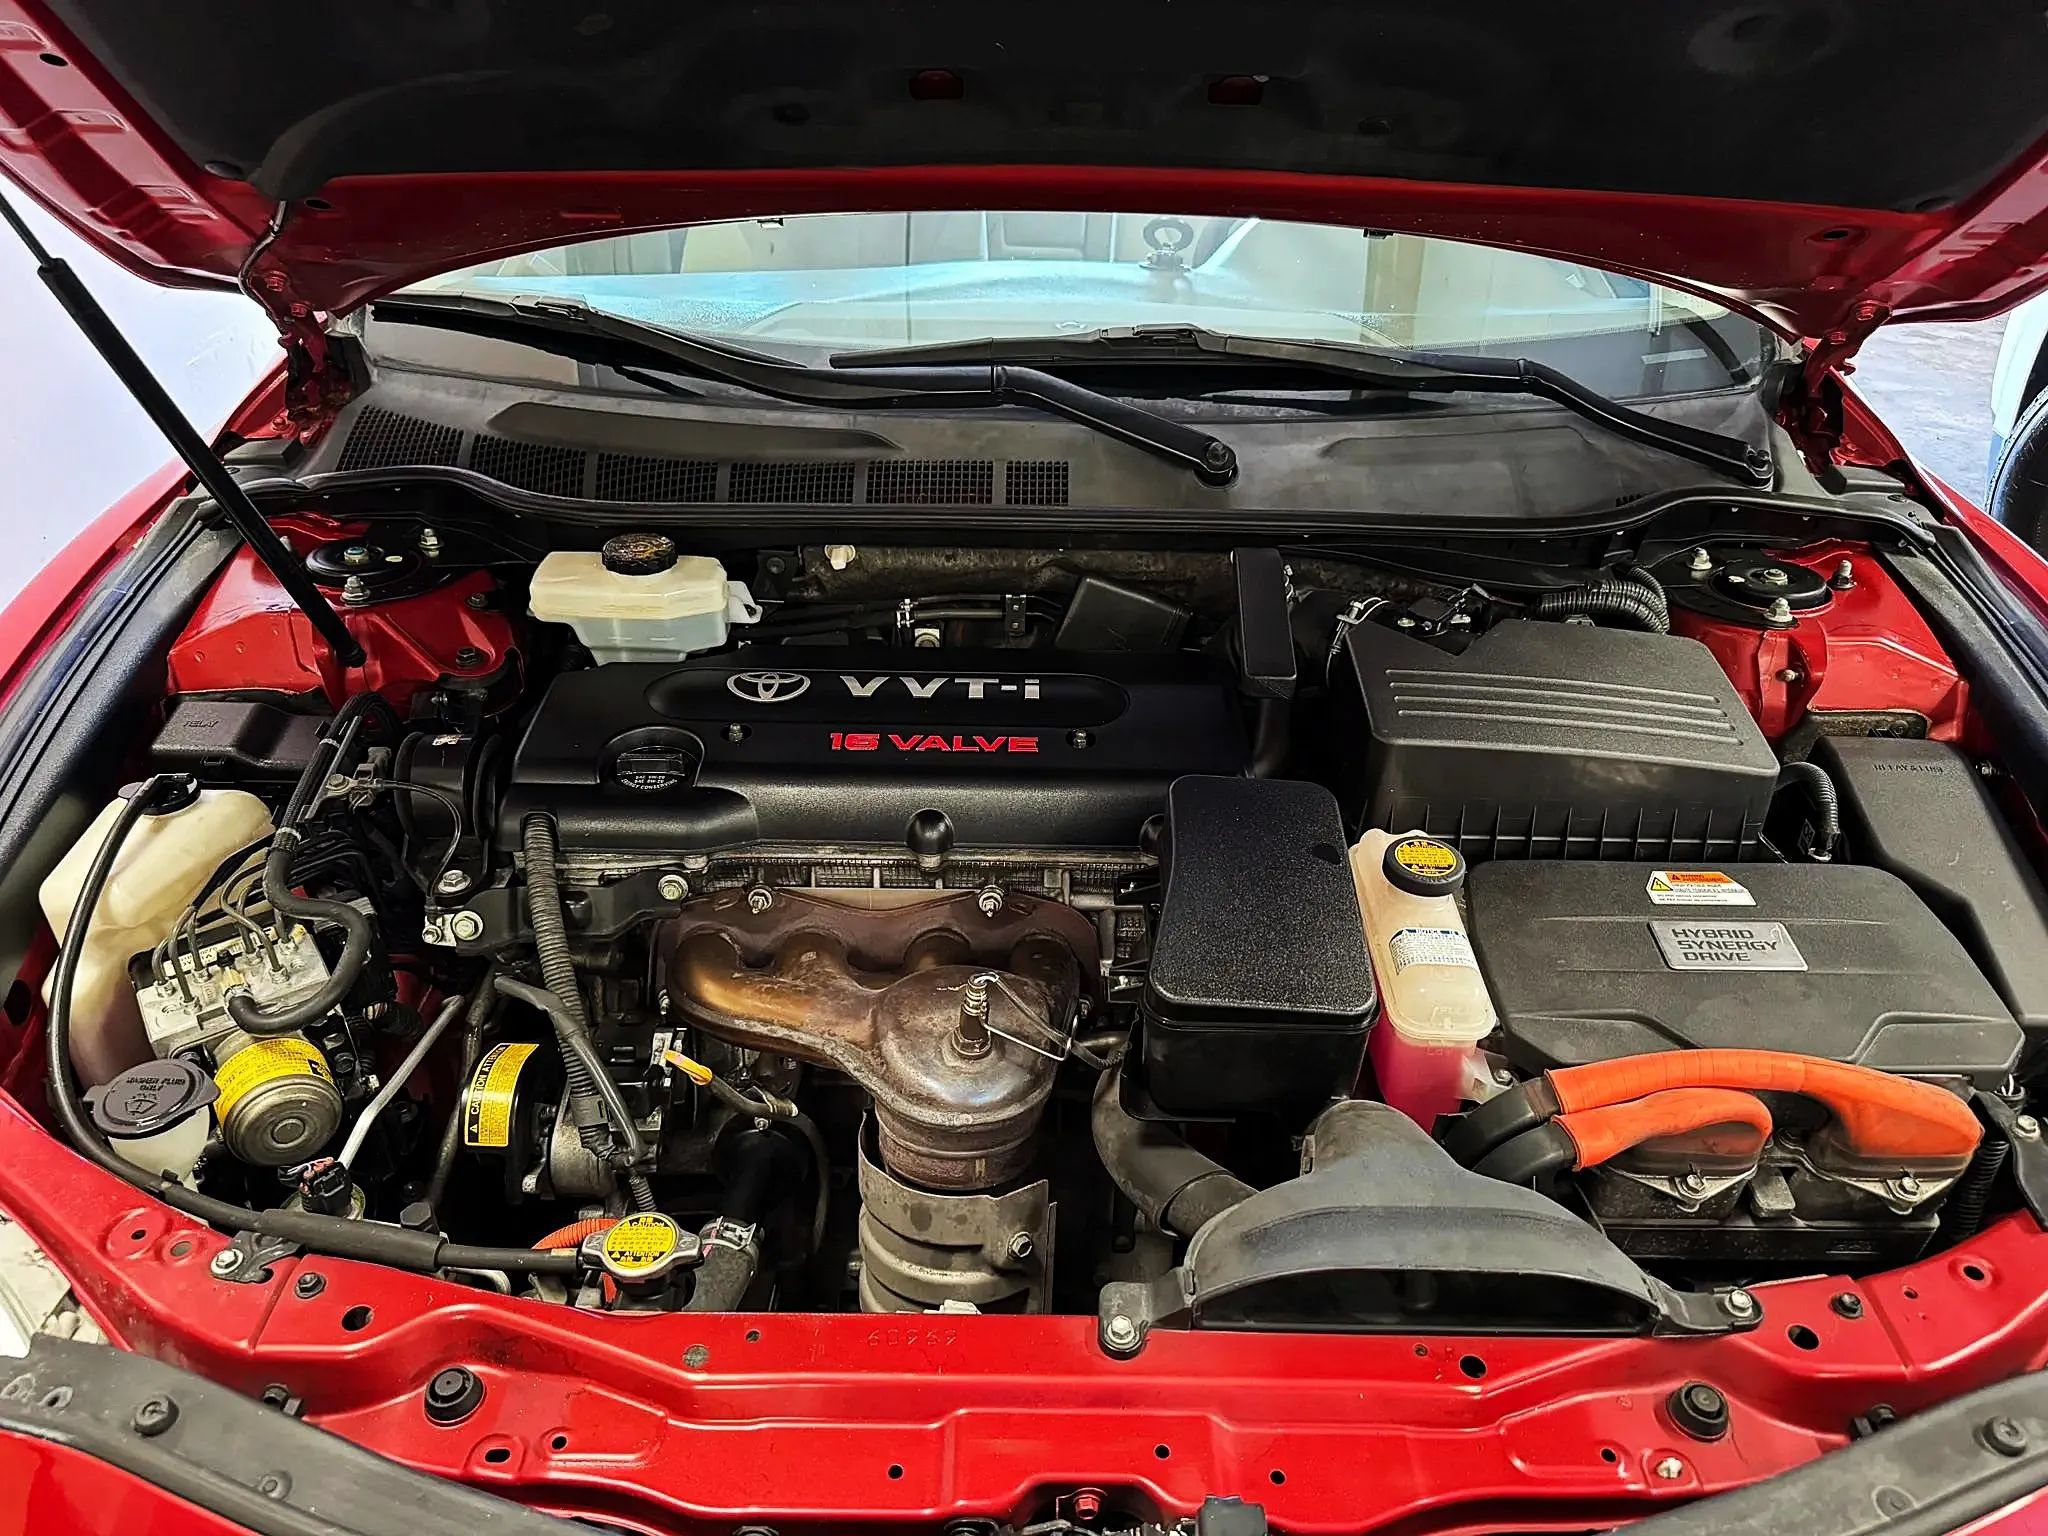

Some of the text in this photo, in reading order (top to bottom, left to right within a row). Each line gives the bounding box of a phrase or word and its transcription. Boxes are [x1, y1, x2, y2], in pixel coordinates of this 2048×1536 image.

[840, 675, 1040, 700] VVT-i
[830, 732, 1039, 752] 16 VALVE
[1672, 929, 1754, 939] HYBRID
[1677, 940, 1777, 950] SYNERGY
[1683, 952, 1751, 961] DRIVE
